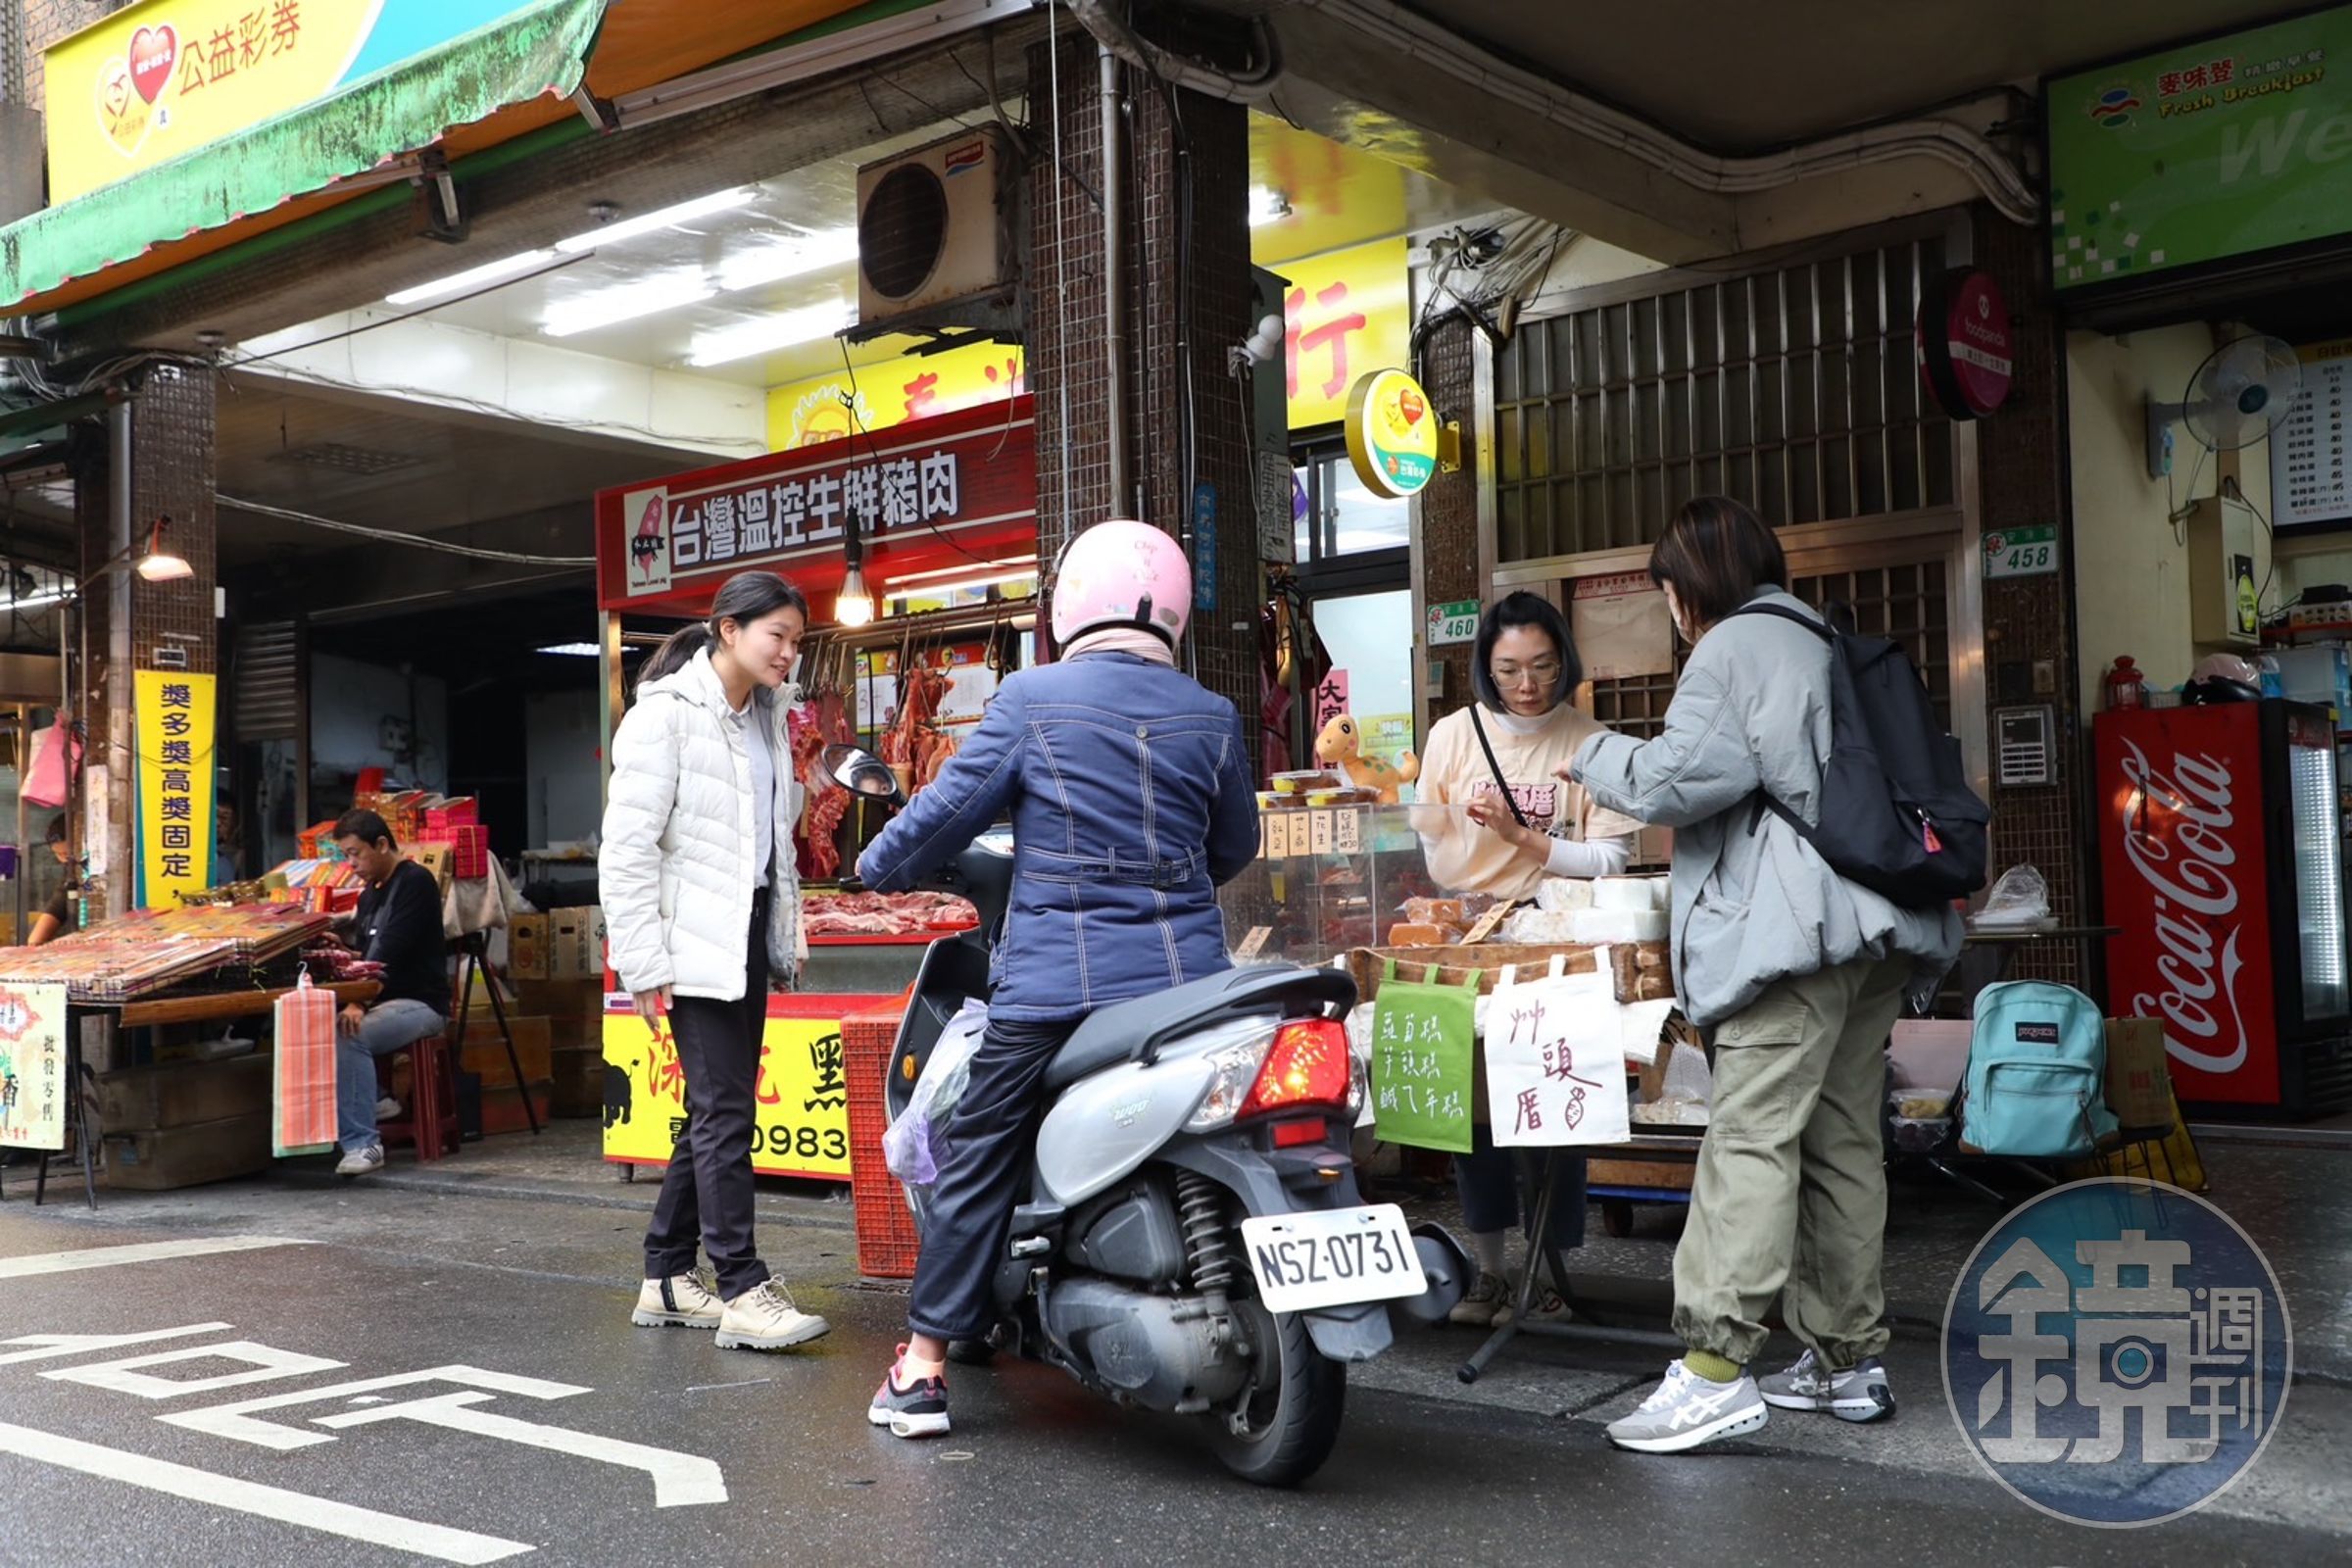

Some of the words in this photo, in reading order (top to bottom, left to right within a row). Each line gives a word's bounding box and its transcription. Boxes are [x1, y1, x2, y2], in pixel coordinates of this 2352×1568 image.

[178, 0, 300, 96] 公益彩券
[2158, 57, 2234, 98] 麥味登
[2160, 93, 2215, 118] Fresh
[2223, 68, 2325, 103] Breakfast
[1284, 280, 1366, 401] 行
[671, 450, 958, 565] 台灣溫控生鮮豬肉
[2008, 547, 2049, 569] 458
[1445, 618, 1475, 638] 460
[2120, 735, 2247, 1073] Coca-Cola
[1385, 1046, 1441, 1079] 芋頭糕
